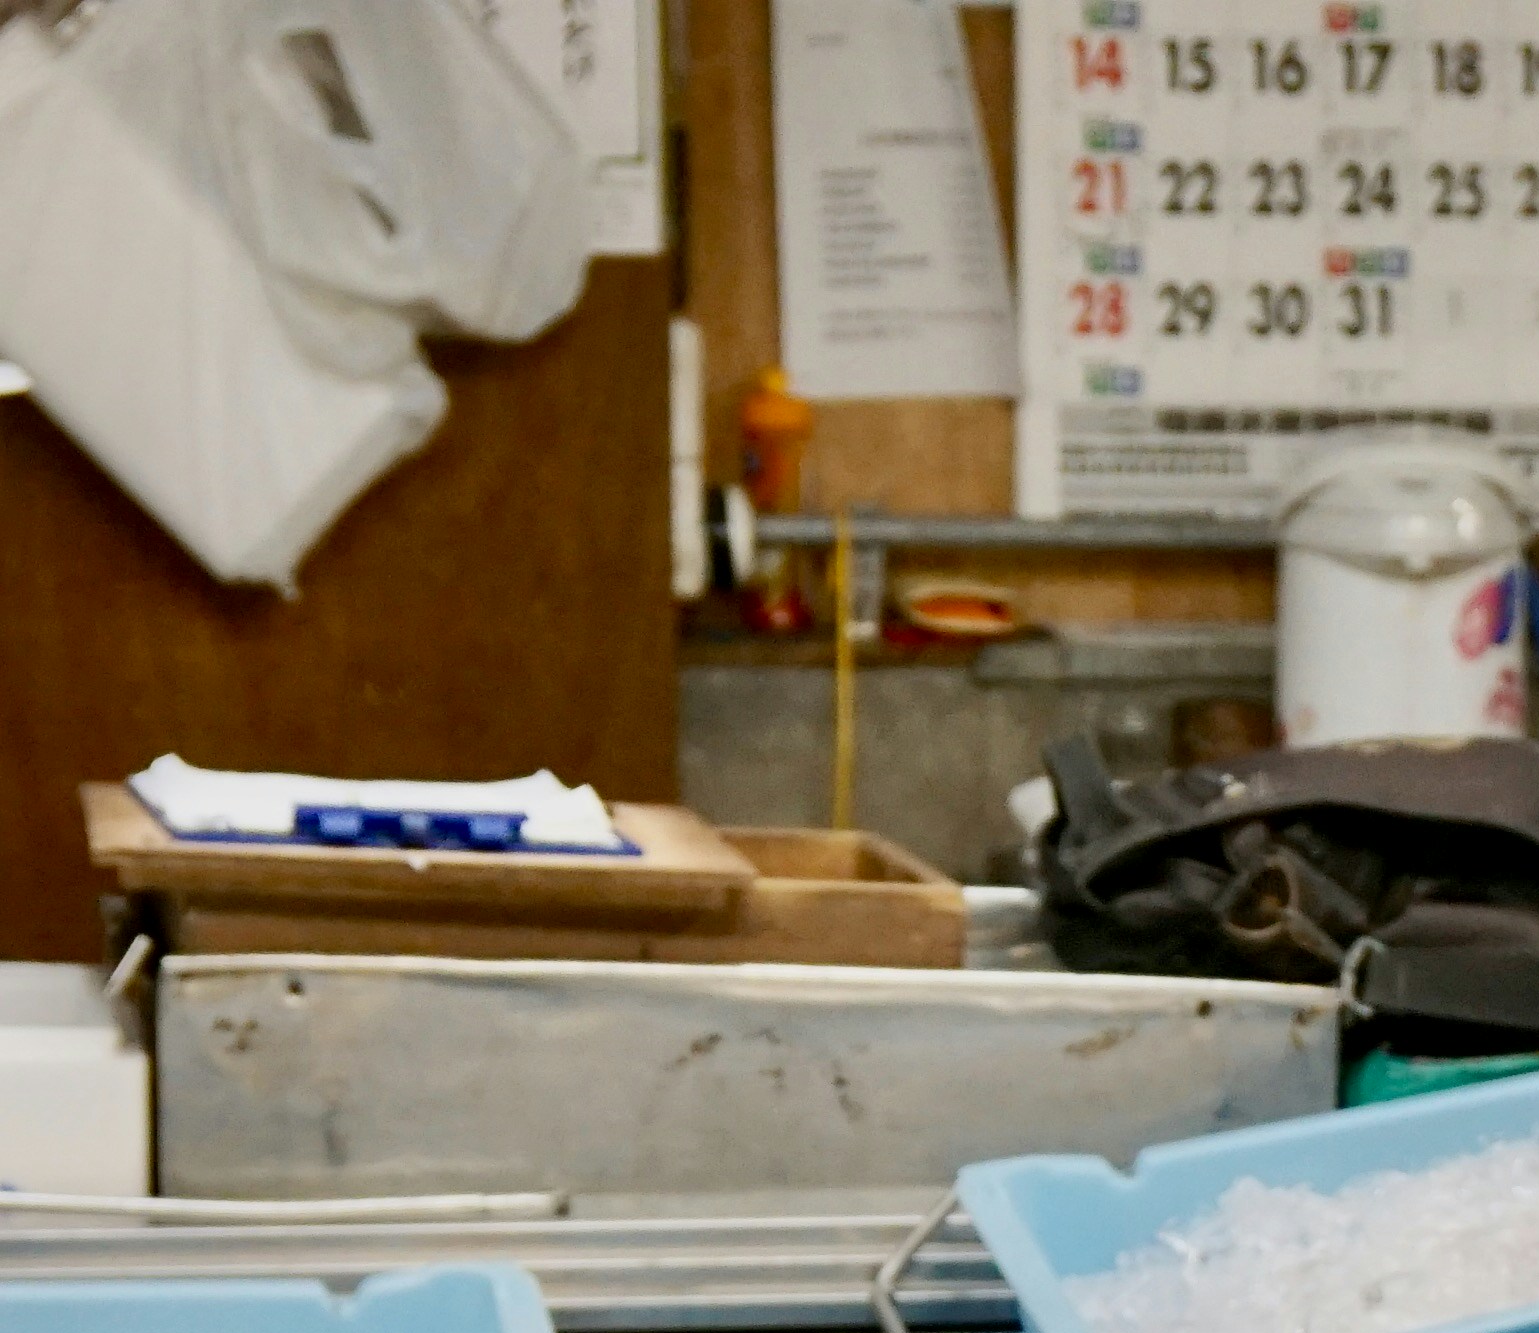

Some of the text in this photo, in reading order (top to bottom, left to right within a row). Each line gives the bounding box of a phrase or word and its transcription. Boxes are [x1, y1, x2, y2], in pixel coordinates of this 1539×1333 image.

[1070, 36, 1125, 93] 14
[1162, 37, 1217, 94] 15
[1248, 38, 1308, 95] 16
[1341, 39, 1394, 95] 17
[1431, 38, 1484, 97] 18
[1072, 157, 1126, 214] 21
[1159, 158, 1219, 216] 22
[1249, 158, 1307, 217] 23
[1338, 160, 1397, 217] 24
[1427, 160, 1487, 220] 25
[1069, 280, 1128, 338] 28
[1158, 280, 1217, 338] 29
[1249, 280, 1310, 339] 30
[1339, 281, 1395, 340] 31
